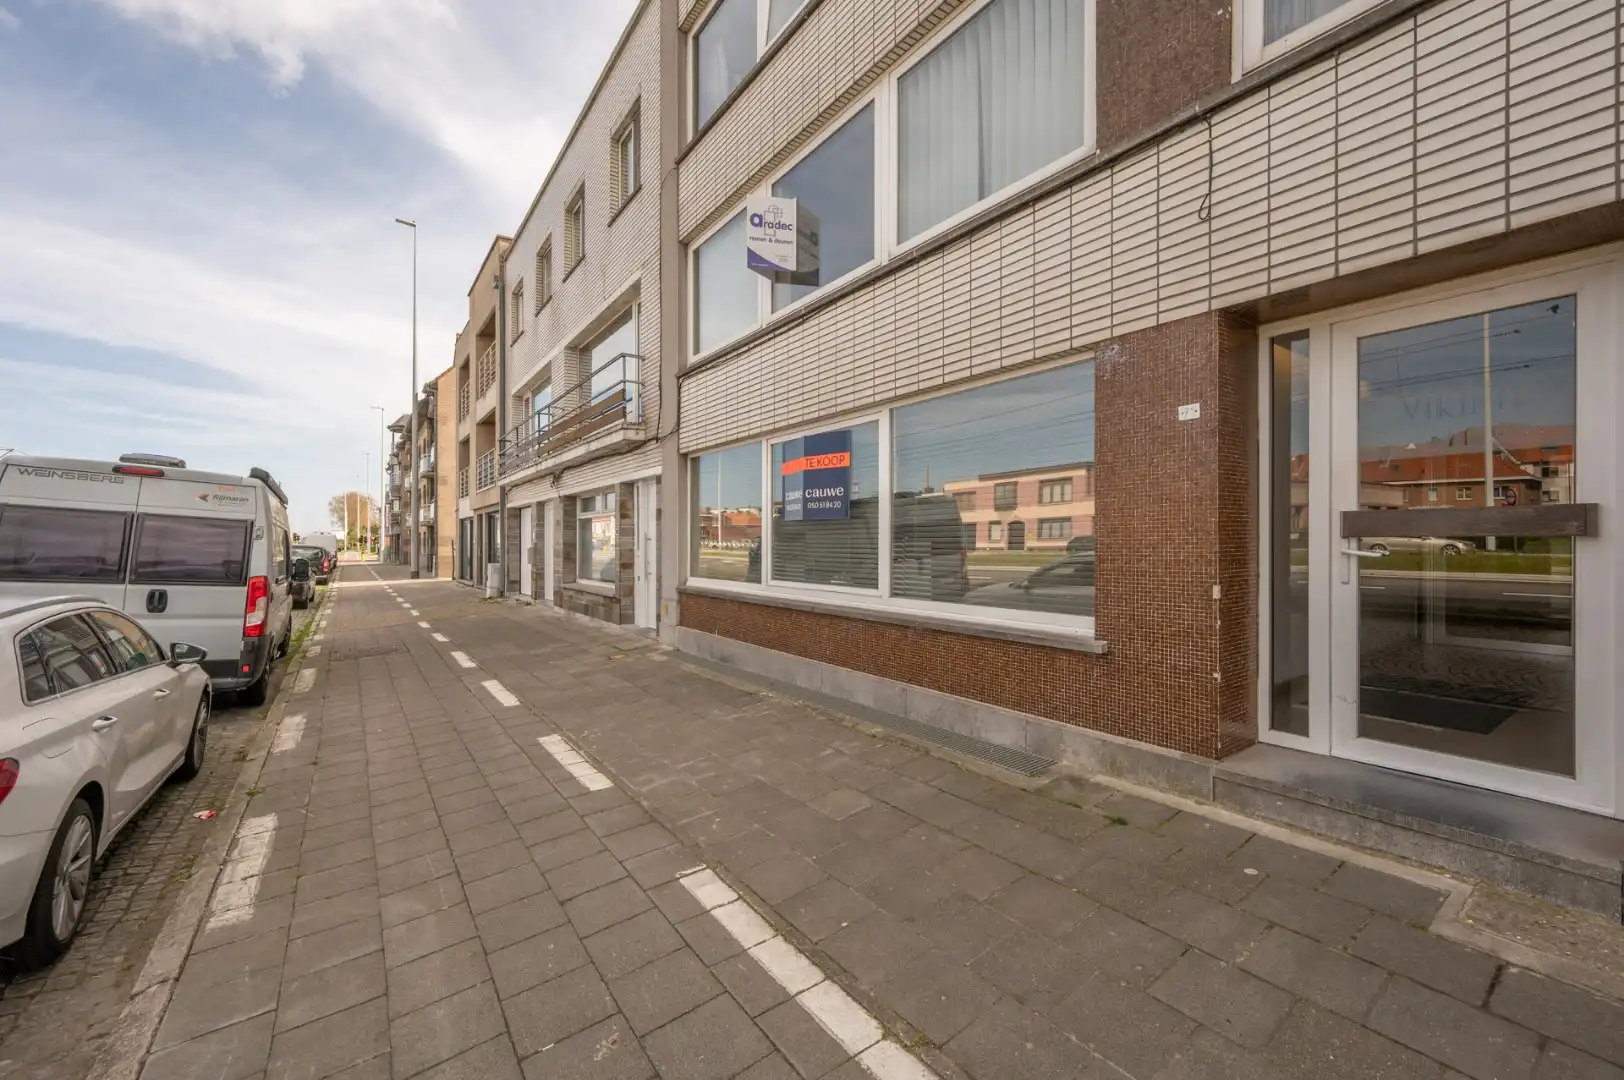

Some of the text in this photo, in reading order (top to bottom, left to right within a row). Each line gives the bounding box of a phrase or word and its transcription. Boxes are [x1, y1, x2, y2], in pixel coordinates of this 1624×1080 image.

[750, 213, 793, 231] aradec
[805, 455, 845, 468] TE KOOP
[17, 467, 125, 484] WEINSBERG
[805, 486, 844, 498] cauwe
